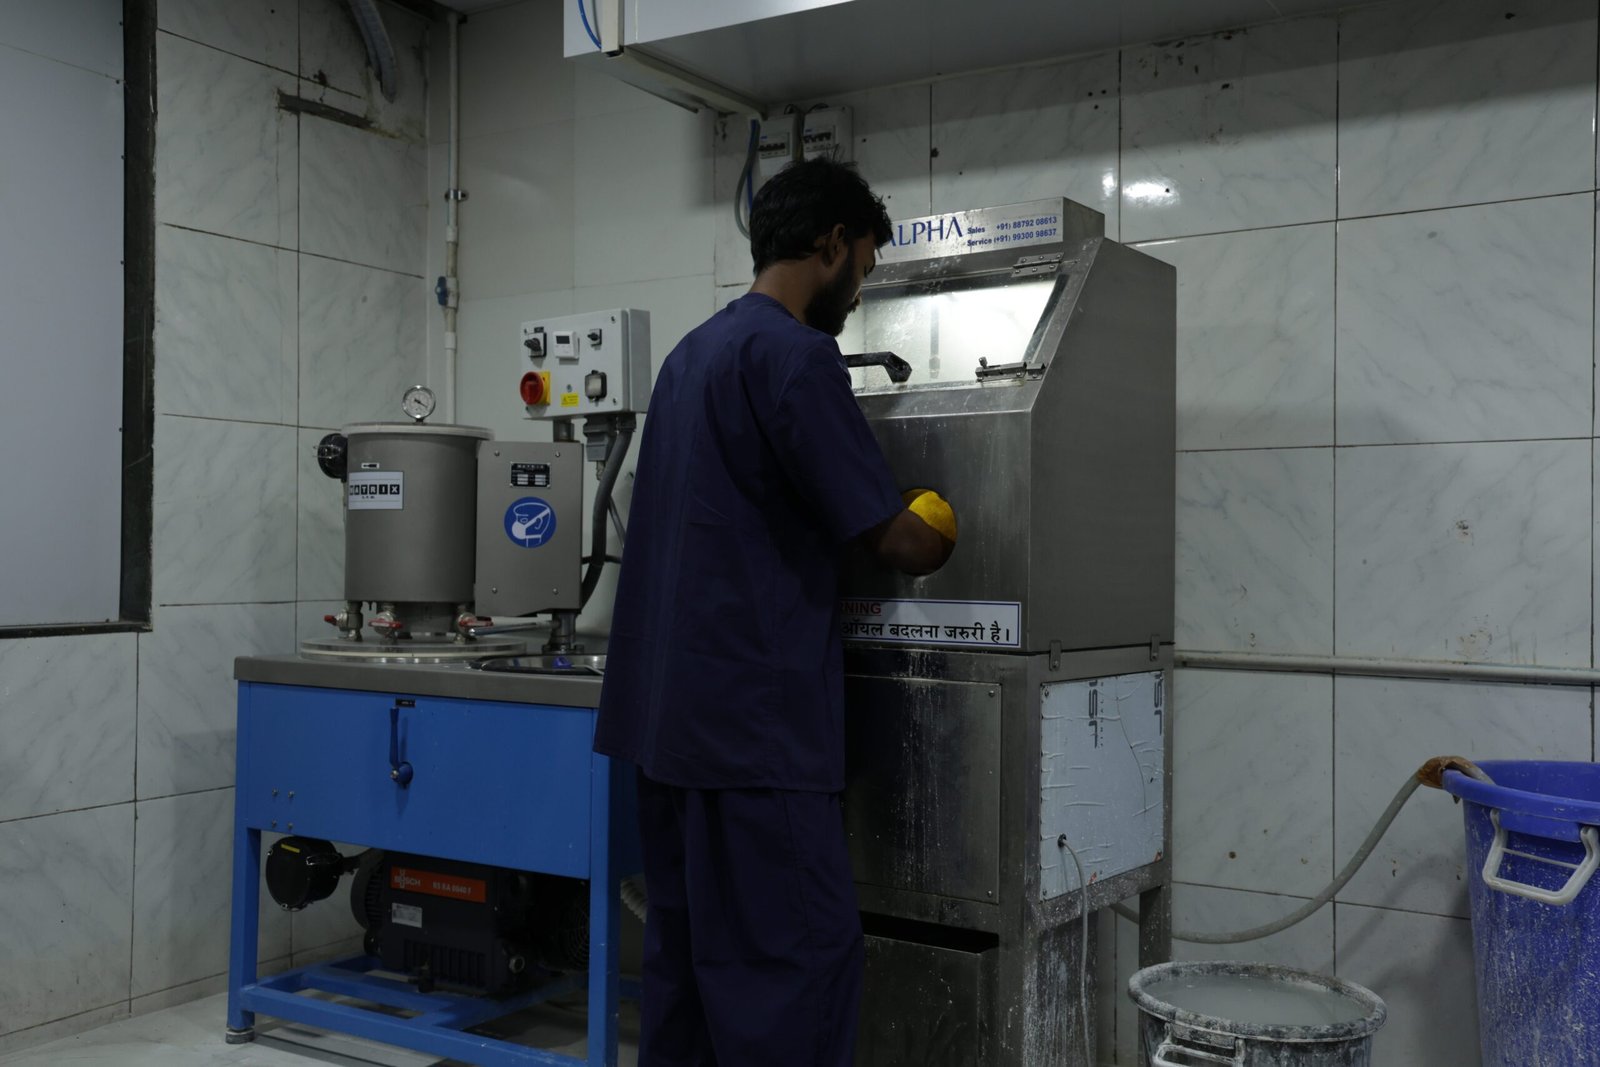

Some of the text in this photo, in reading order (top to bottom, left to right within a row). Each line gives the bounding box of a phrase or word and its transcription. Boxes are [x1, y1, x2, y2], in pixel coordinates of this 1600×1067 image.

[889, 216, 963, 246] LPHA
[967, 226, 985, 234] Sales
[1012, 219, 1034, 229] 88792
[1035, 216, 1057, 225] 08613
[967, 228, 1057, 247] Service (+91) 99300 98637
[889, 623, 940, 639] बदलना
[1088, 680, 1098, 749] JS
[1154, 672, 1163, 736] JS
